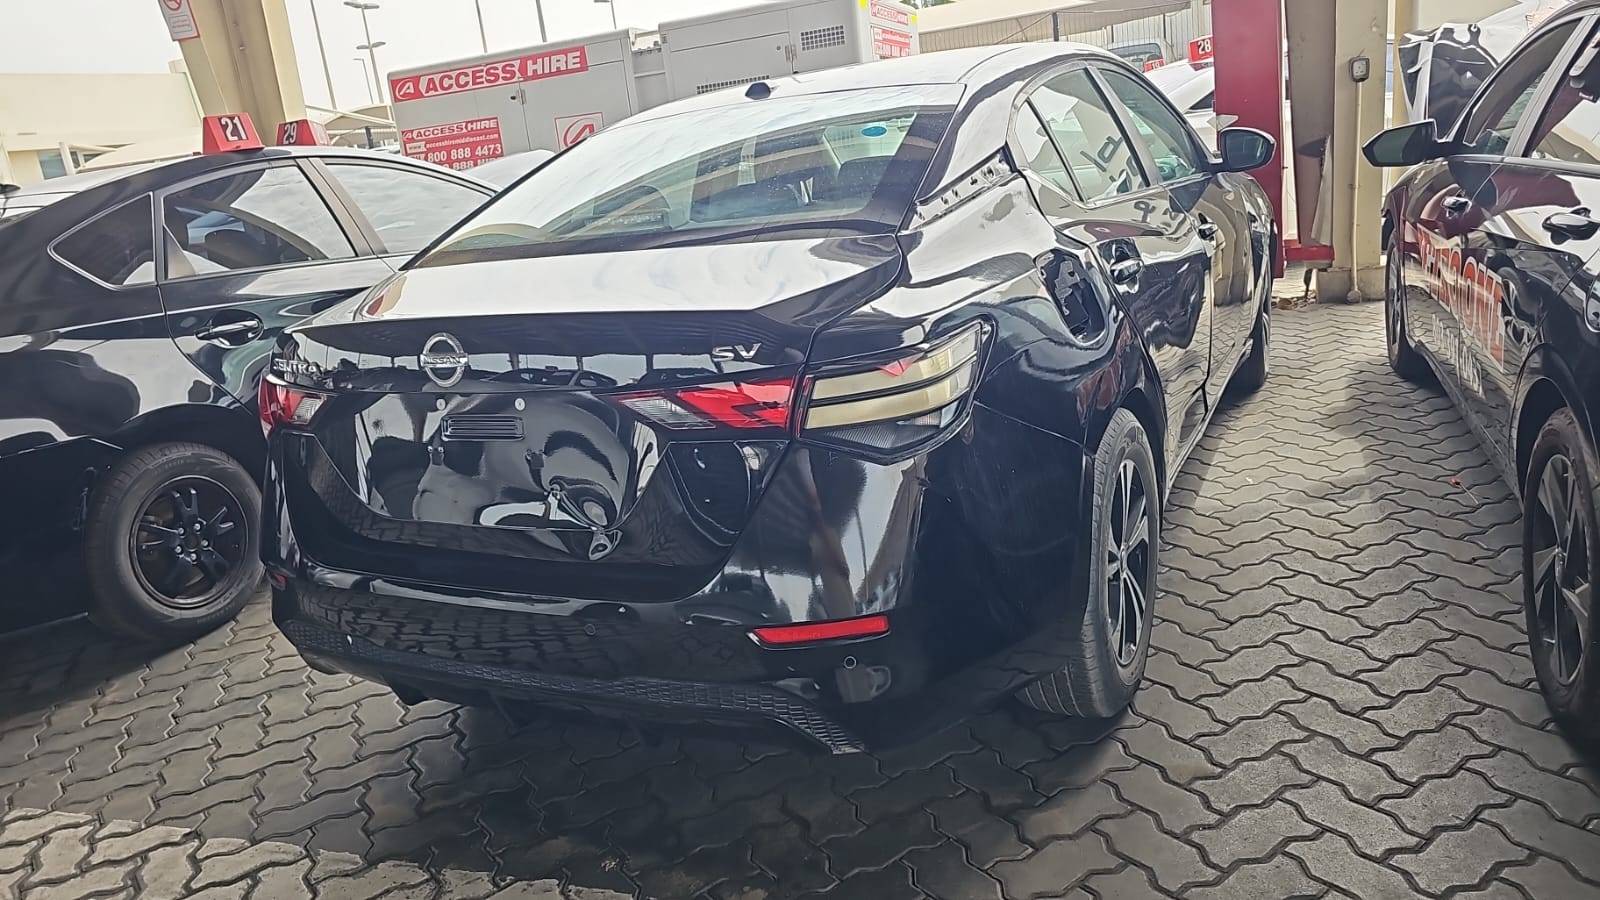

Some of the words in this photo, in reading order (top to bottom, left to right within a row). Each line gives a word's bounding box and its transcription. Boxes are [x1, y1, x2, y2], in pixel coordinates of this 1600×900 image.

[1198, 39, 1211, 54] 28
[424, 63, 517, 94] ACCESS
[526, 51, 581, 76] HIRE
[221, 116, 247, 141] 21
[283, 123, 297, 145] 29
[415, 125, 464, 139] ACCESS
[467, 119, 498, 131] HIRE
[427, 150, 447, 162] 800
[450, 147, 471, 160] 888
[475, 143, 502, 156] 4473
[423, 355, 463, 364] NISSAN
[712, 342, 762, 361] SV
[272, 358, 317, 375] SENTRA
